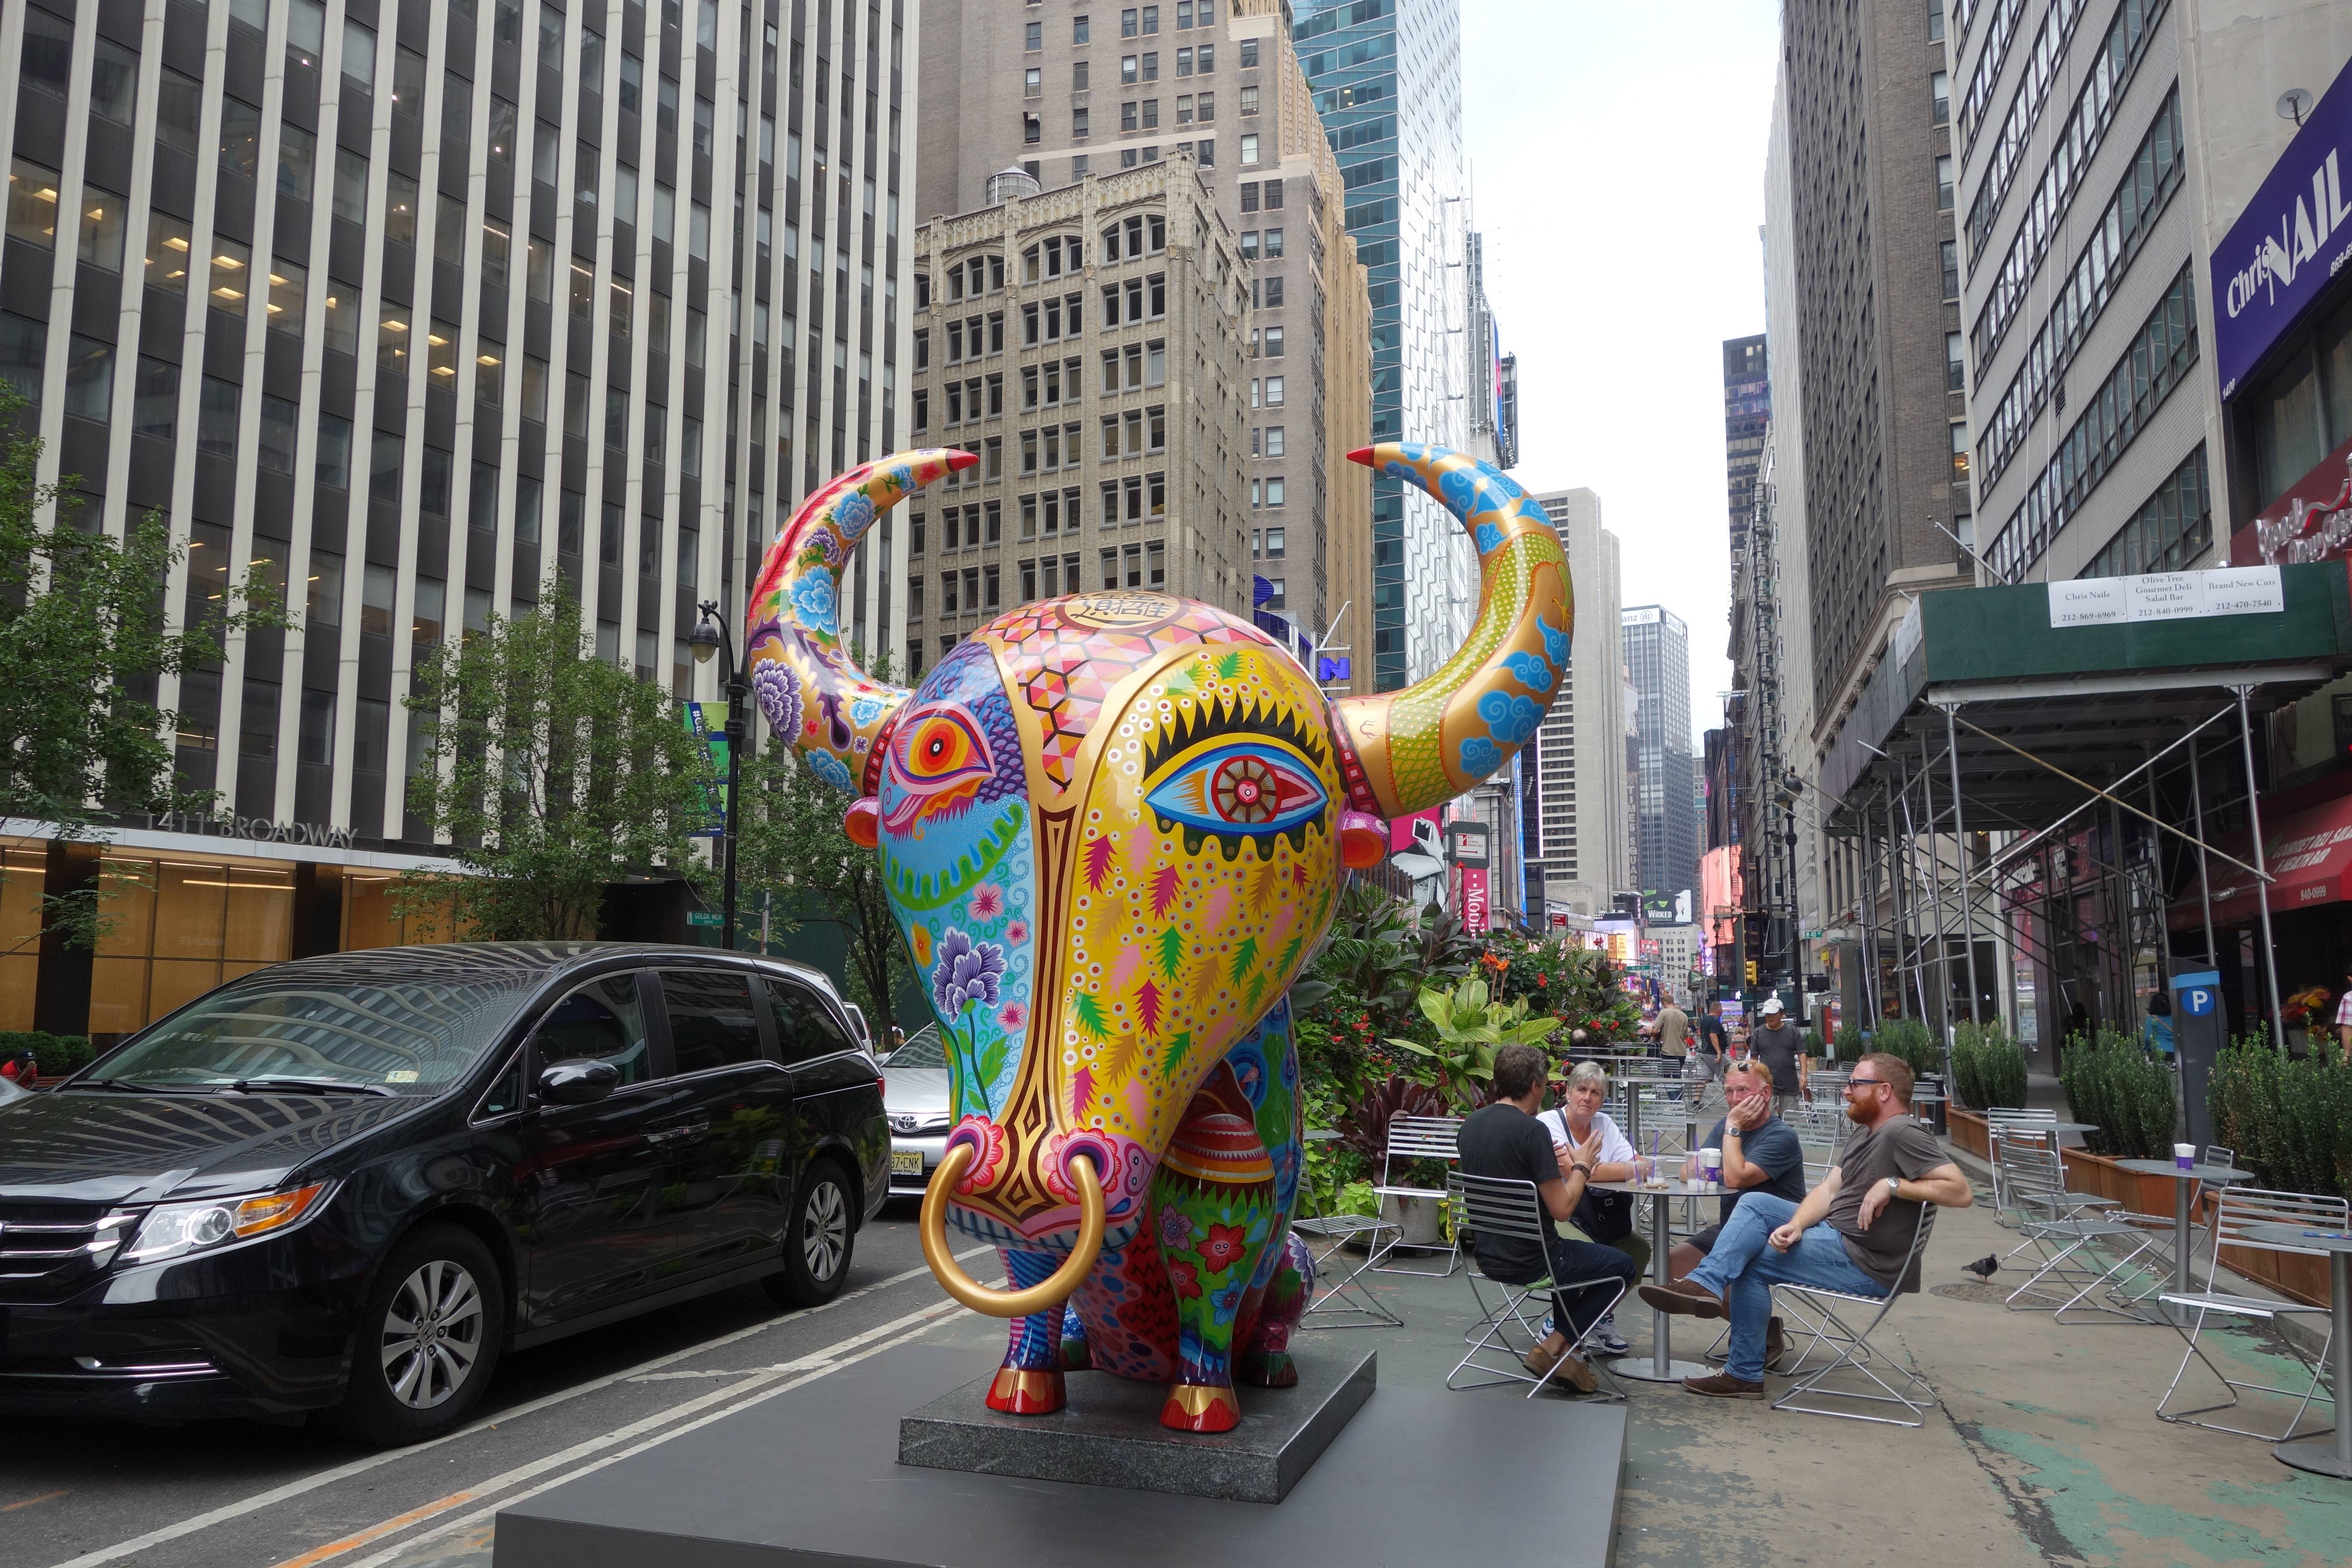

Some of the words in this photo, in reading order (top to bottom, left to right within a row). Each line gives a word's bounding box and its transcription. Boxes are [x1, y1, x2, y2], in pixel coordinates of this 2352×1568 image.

[2135, 585, 2172, 594] Gourmet
[2208, 582, 2234, 590] Brand
[2065, 593, 2088, 601] Chris
[2089, 591, 2110, 599] Nails
[2216, 600, 2272, 610] 212-470-7540
[2138, 606, 2193, 616] 212-840-0999
[2062, 611, 2116, 622] 212-869-6969
[220, 815, 359, 849] BROADWAY
[2300, 885, 2326, 901] 840-0999
[2193, 991, 2208, 1012] P
